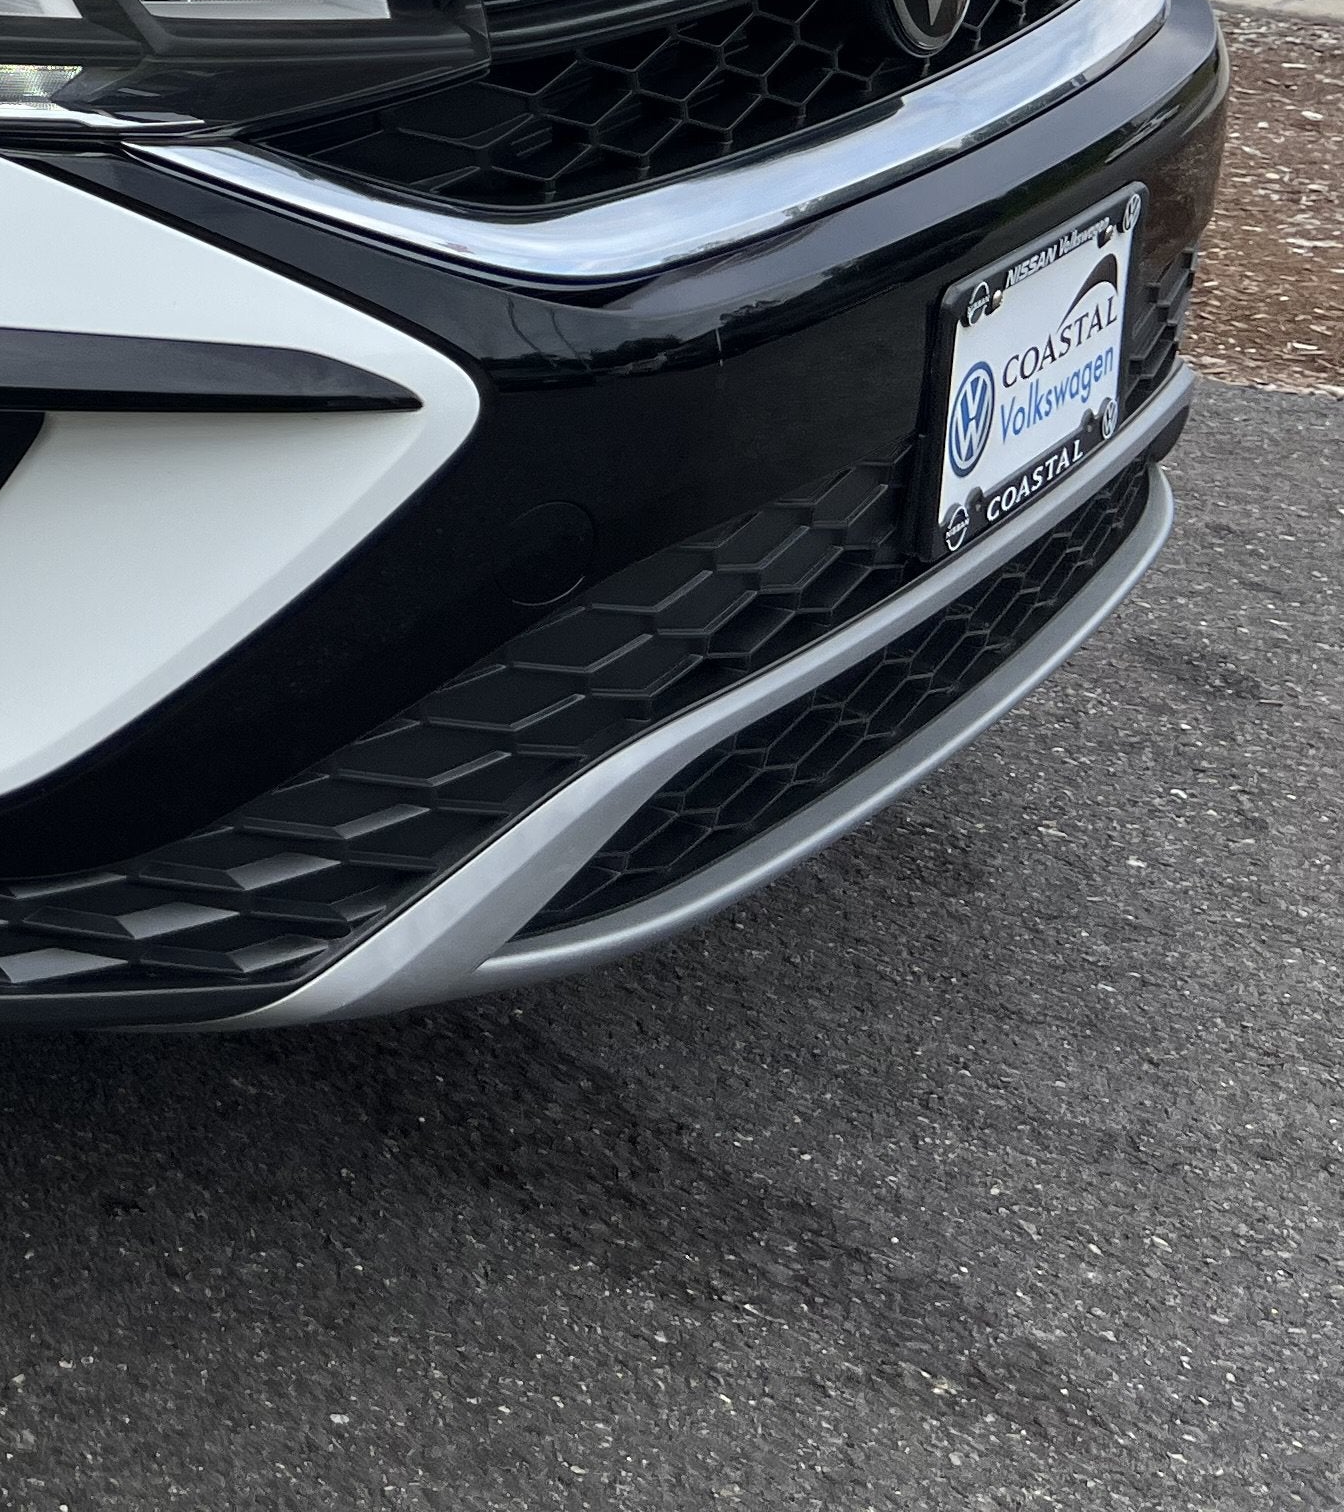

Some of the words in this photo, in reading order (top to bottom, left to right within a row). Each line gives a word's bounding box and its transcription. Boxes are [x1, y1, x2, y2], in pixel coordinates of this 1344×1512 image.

[1004, 244, 1057, 289] NISSAN
[1002, 295, 1118, 388] COASTAL
[1000, 346, 1115, 444] Volkswagen
[986, 438, 1084, 522] COASTAL
